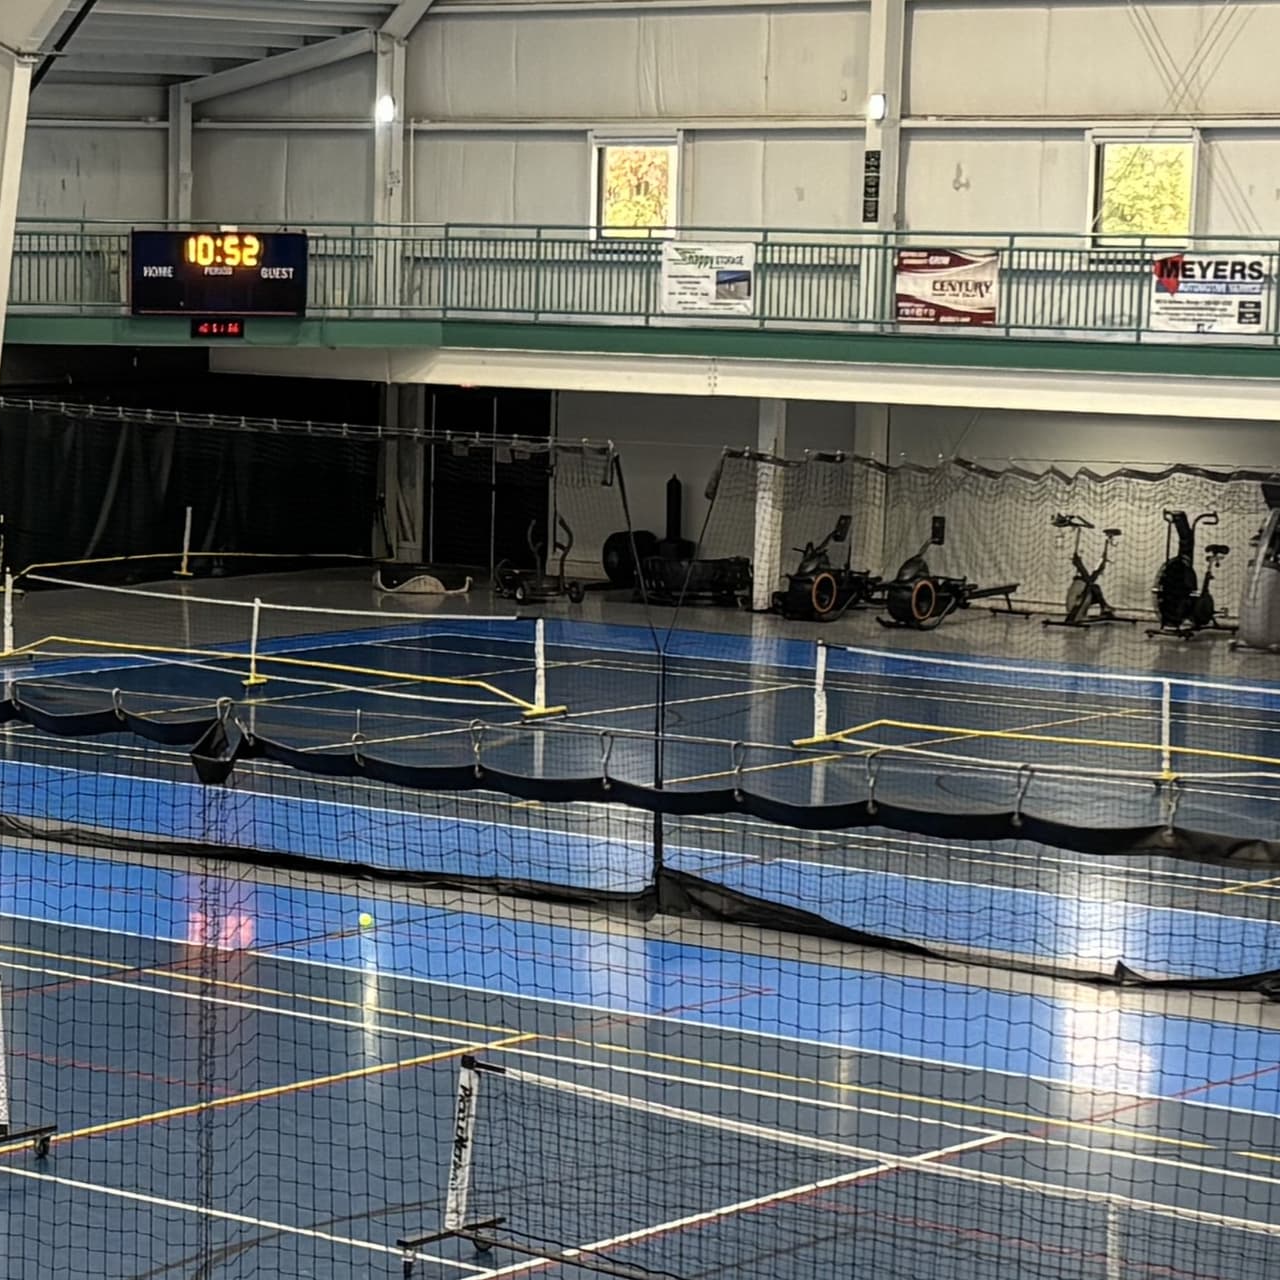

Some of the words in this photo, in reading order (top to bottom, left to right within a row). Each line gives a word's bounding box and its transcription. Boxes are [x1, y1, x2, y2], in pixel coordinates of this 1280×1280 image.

[187, 234, 260, 266] 10:52
[260, 267, 294, 279] GUEST
[1160, 260, 1264, 281] MEYERS
[931, 280, 993, 298] CENTURY
